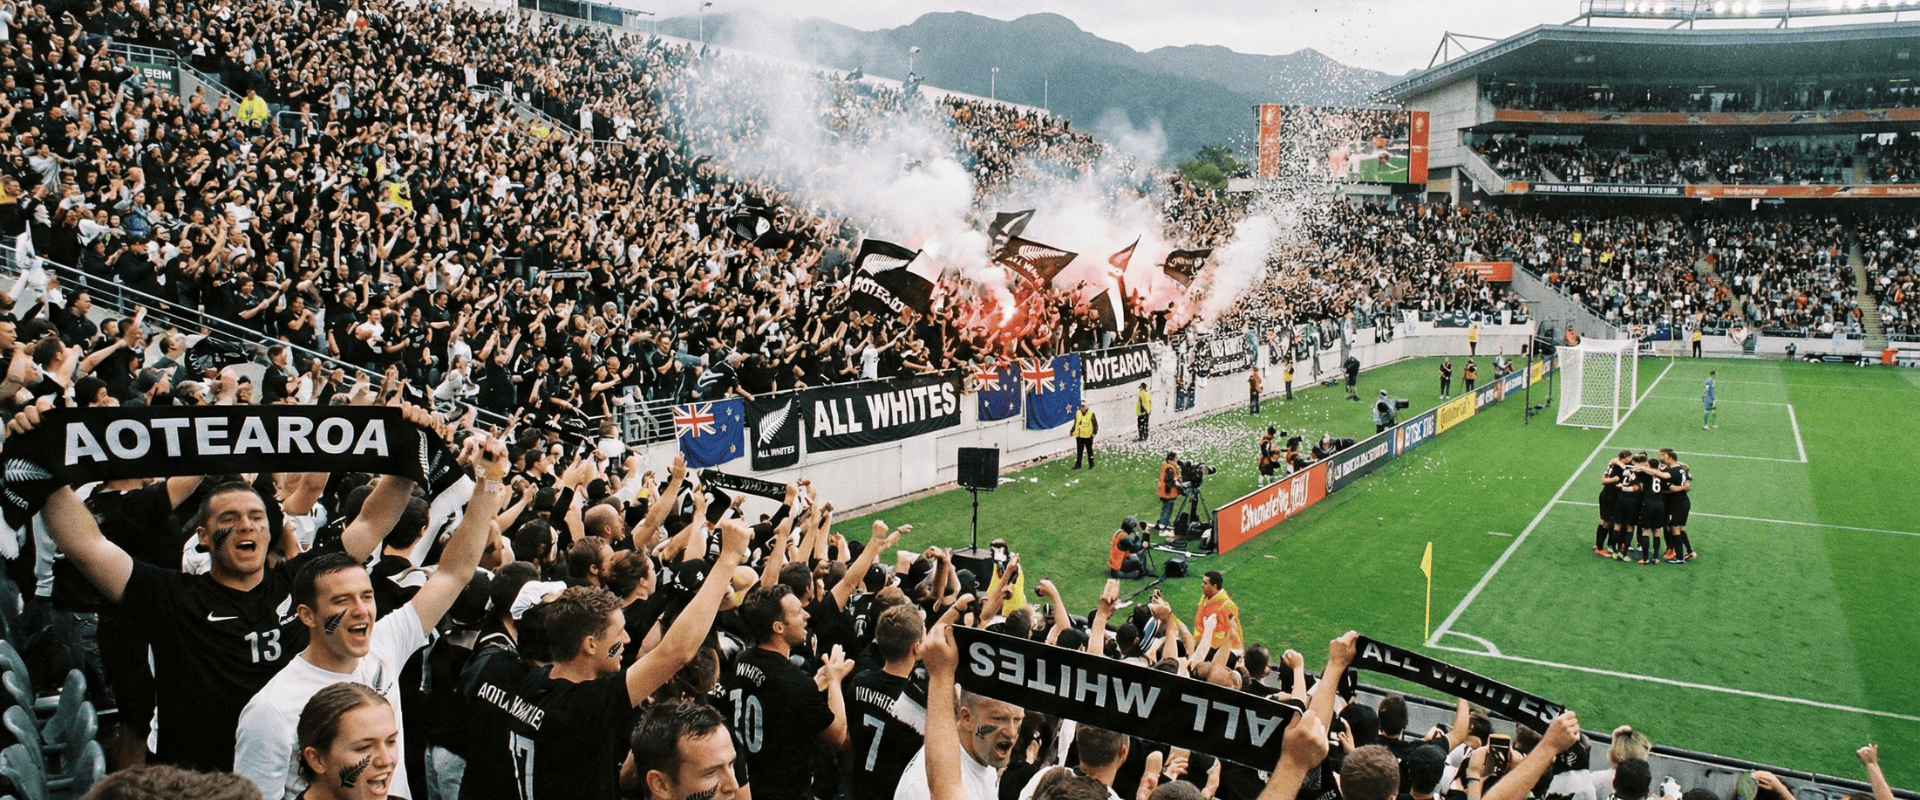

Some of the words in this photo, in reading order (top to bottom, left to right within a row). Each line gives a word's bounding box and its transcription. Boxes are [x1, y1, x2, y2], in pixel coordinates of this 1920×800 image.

[1086, 349, 1151, 383] AOTEAROA
[812, 397, 862, 438] ALL
[866, 382, 956, 429] WHITES
[64, 416, 389, 465] AOTEAROA
[757, 449, 770, 458] ALL
[770, 445, 795, 456] WHITES
[1652, 477, 1661, 493] 6
[244, 628, 282, 664] 13
[1362, 642, 1420, 672] ALL
[969, 642, 1161, 719] WHITES
[729, 688, 764, 753] 10
[863, 713, 886, 772] 7
[1181, 693, 1284, 748] ALL
